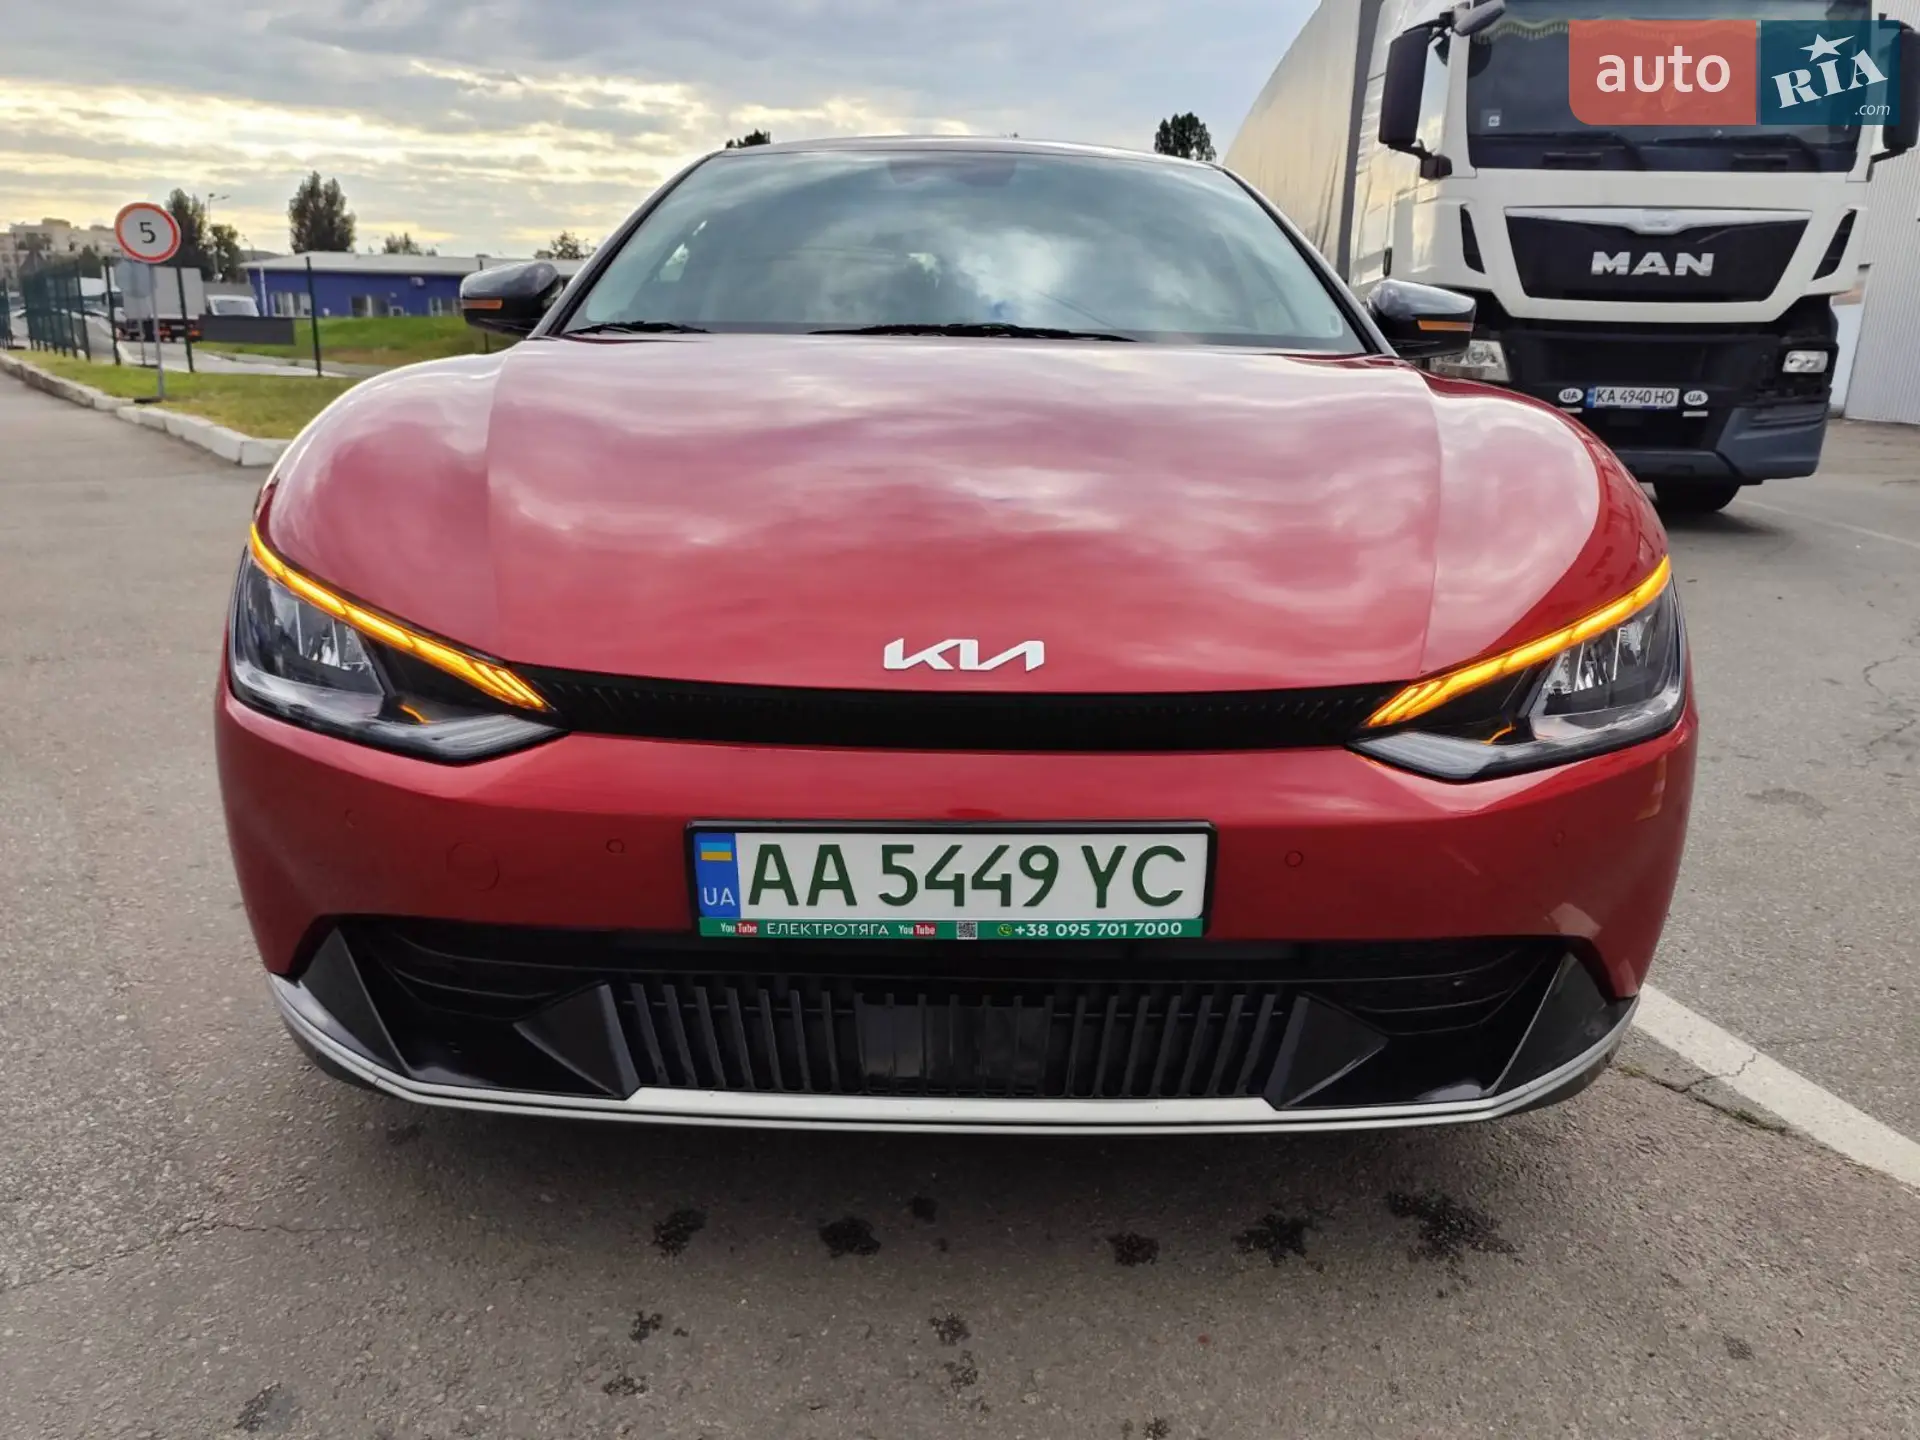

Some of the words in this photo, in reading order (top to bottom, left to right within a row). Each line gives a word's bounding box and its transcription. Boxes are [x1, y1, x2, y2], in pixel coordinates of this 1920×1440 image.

[139, 221, 157, 245] 5
[1591, 251, 1715, 277] MAN
[1562, 391, 1579, 400] UA
[1595, 389, 1619, 403] KA
[1620, 389, 1651, 403] 4940
[1654, 390, 1676, 404] HO
[1687, 393, 1704, 402] UA
[884, 637, 1045, 671] KIA
[748, 843, 858, 907] AA
[877, 843, 1060, 908] 5449
[1081, 844, 1187, 909] YC
[703, 887, 736, 907] UA
[766, 922, 890, 937] ЕЛЕКТРОТЯГА
[1014, 923, 1050, 937] +38
[1055, 923, 1091, 937] 095
[1096, 923, 1128, 937] 701
[1133, 922, 1183, 936] 7000
